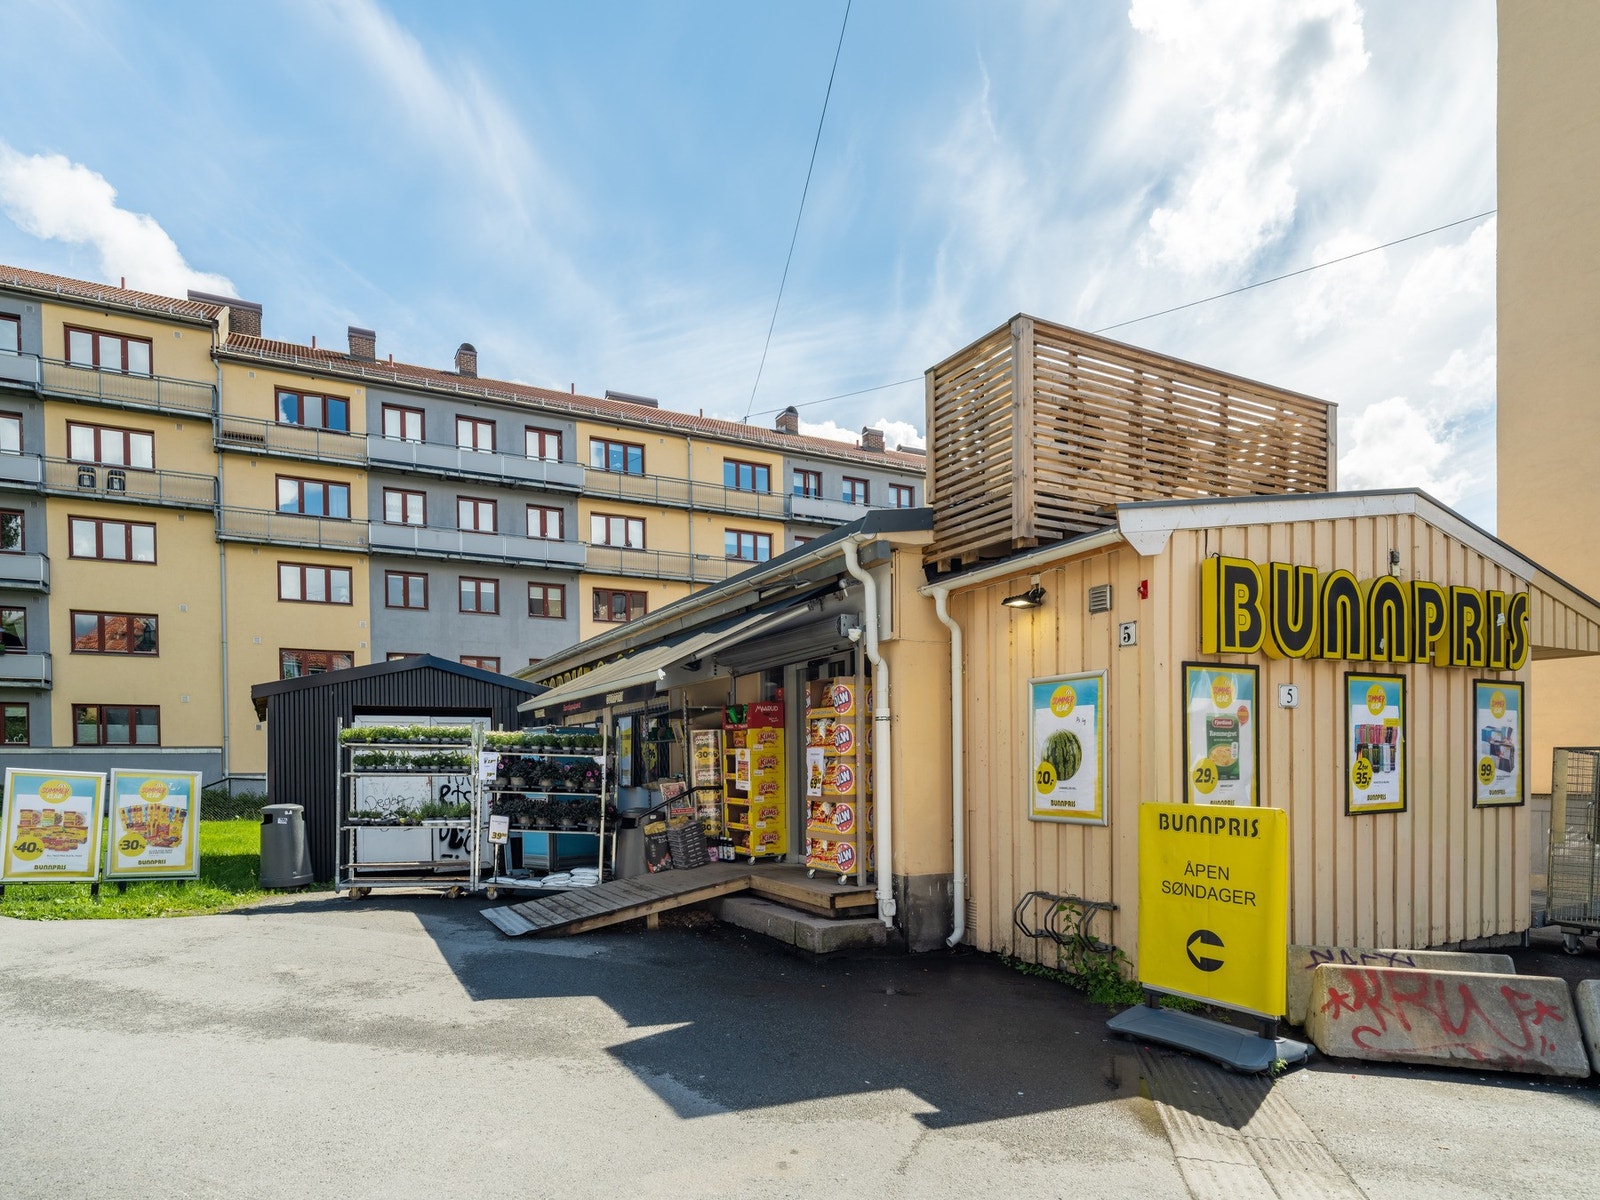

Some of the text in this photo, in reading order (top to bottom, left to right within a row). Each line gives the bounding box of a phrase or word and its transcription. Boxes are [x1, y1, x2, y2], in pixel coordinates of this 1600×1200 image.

[1202, 556, 1529, 671] BUNNPRIS
[1123, 625, 1131, 643] 5
[1052, 696, 1075, 706] SOMMER
[1286, 689, 1294, 704] 5
[755, 705, 779, 713] MAARUD
[1051, 799, 1076, 807] BUNNPRIS
[1159, 813, 1259, 838] BUNNPRIS
[1184, 860, 1230, 881] ÅPEN
[1161, 880, 1257, 907] SØNDAGER
